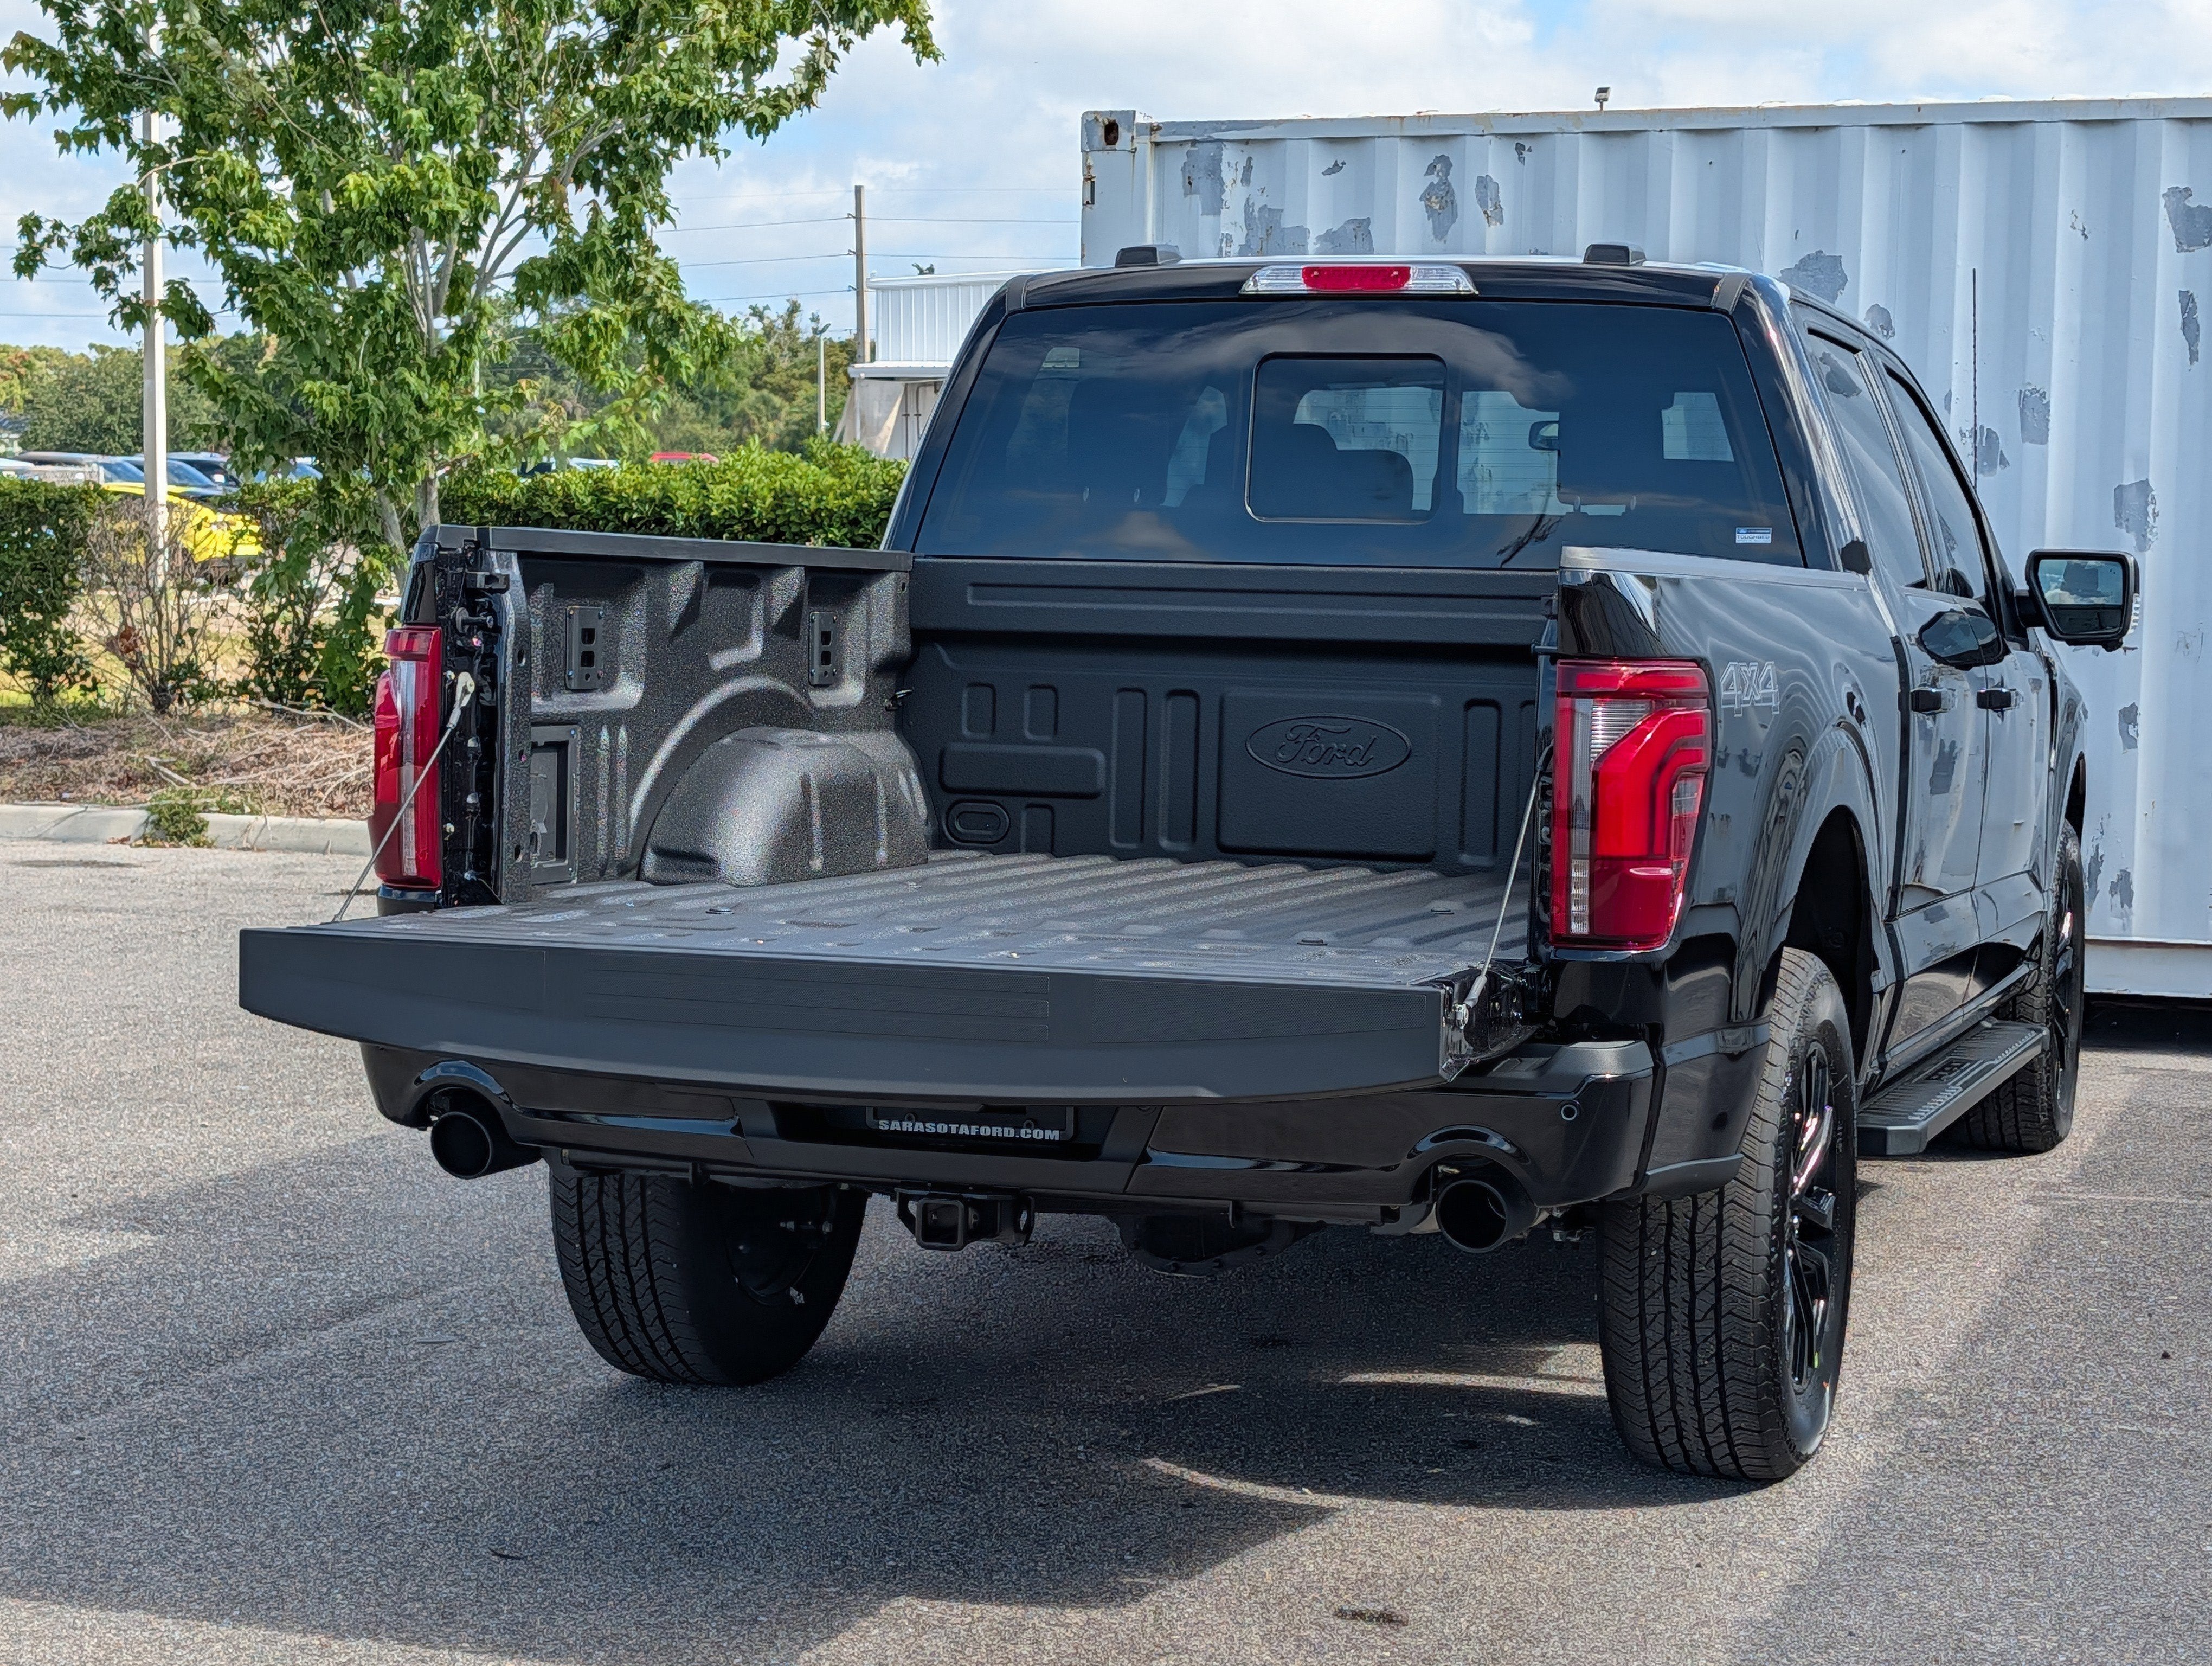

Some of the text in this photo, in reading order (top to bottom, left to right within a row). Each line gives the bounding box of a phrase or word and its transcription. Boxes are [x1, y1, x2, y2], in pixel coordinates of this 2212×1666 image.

[1720, 661, 1780, 717] 4X4
[1276, 722, 1378, 767] Ford
[878, 1120, 1059, 1140] SARASOTAFORD.COM
